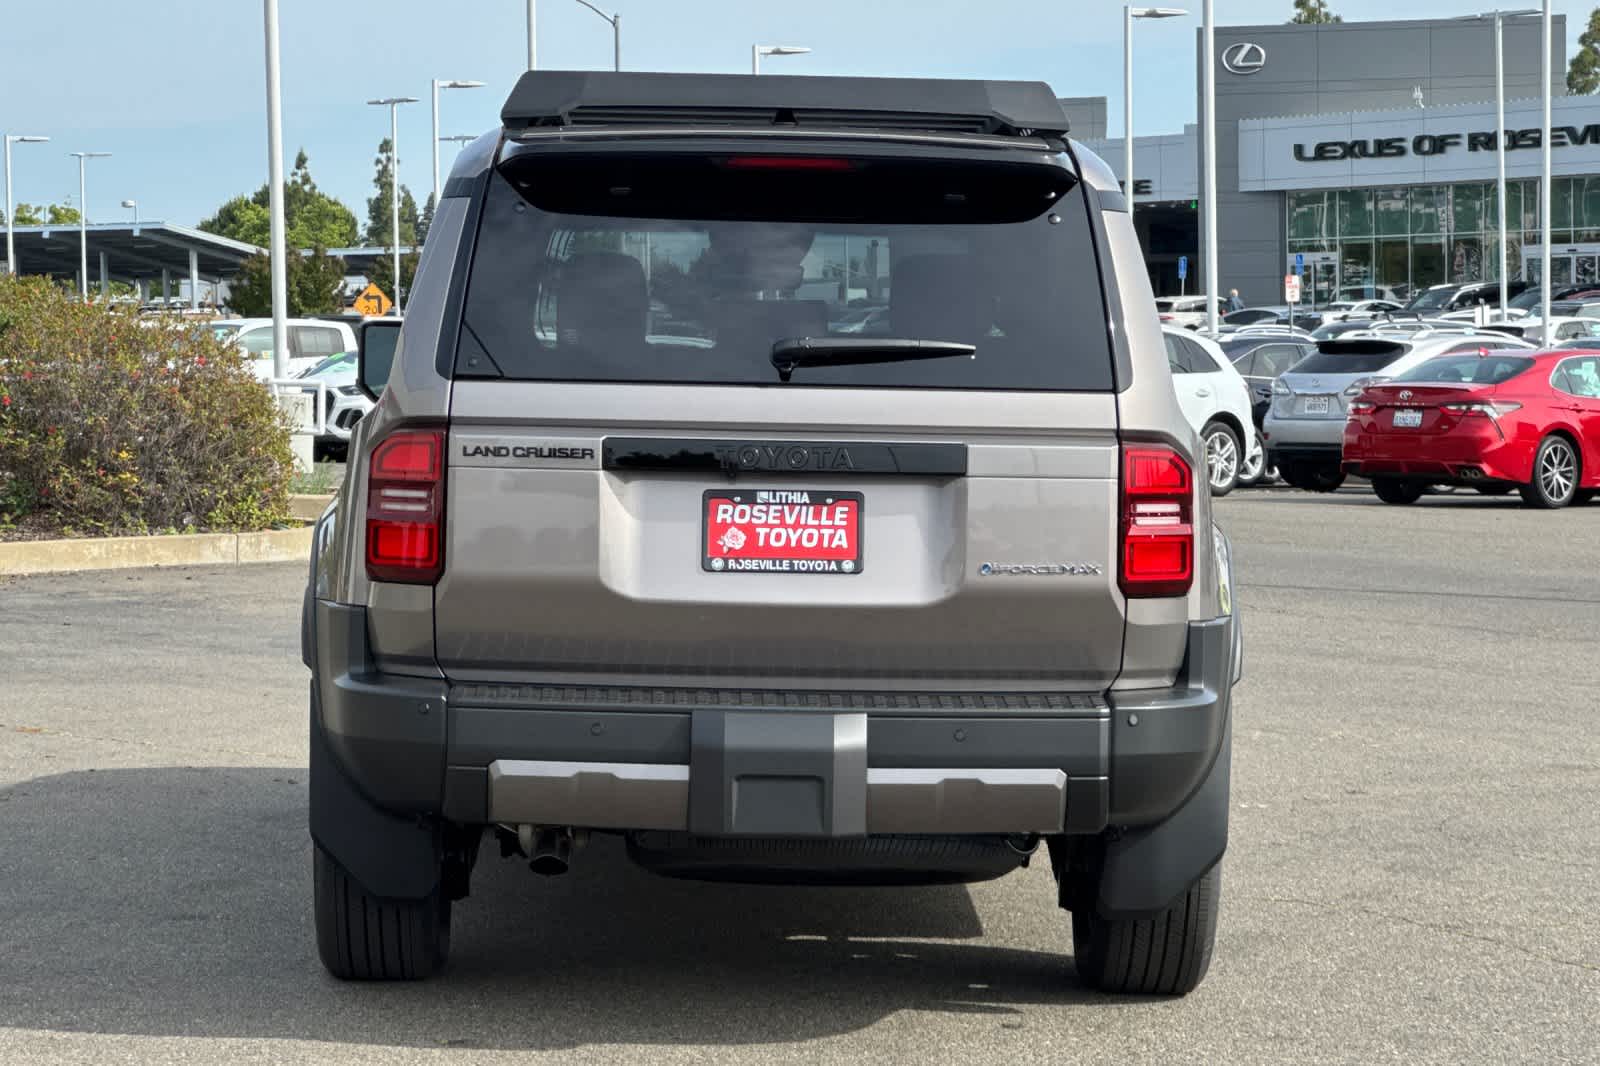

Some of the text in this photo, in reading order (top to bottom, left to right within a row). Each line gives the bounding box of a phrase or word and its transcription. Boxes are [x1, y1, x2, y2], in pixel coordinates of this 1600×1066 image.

[1293, 138, 1406, 162] LEXUS
[1412, 133, 1463, 156] OF
[462, 445, 595, 459] LAND CRUISER
[713, 444, 856, 470] TOYOTA
[768, 491, 810, 504] LITHIA
[716, 504, 849, 526] ROSEVILLE
[755, 527, 849, 549] TOYOTA
[728, 559, 837, 571] ROSEVILLE TOYOTA
